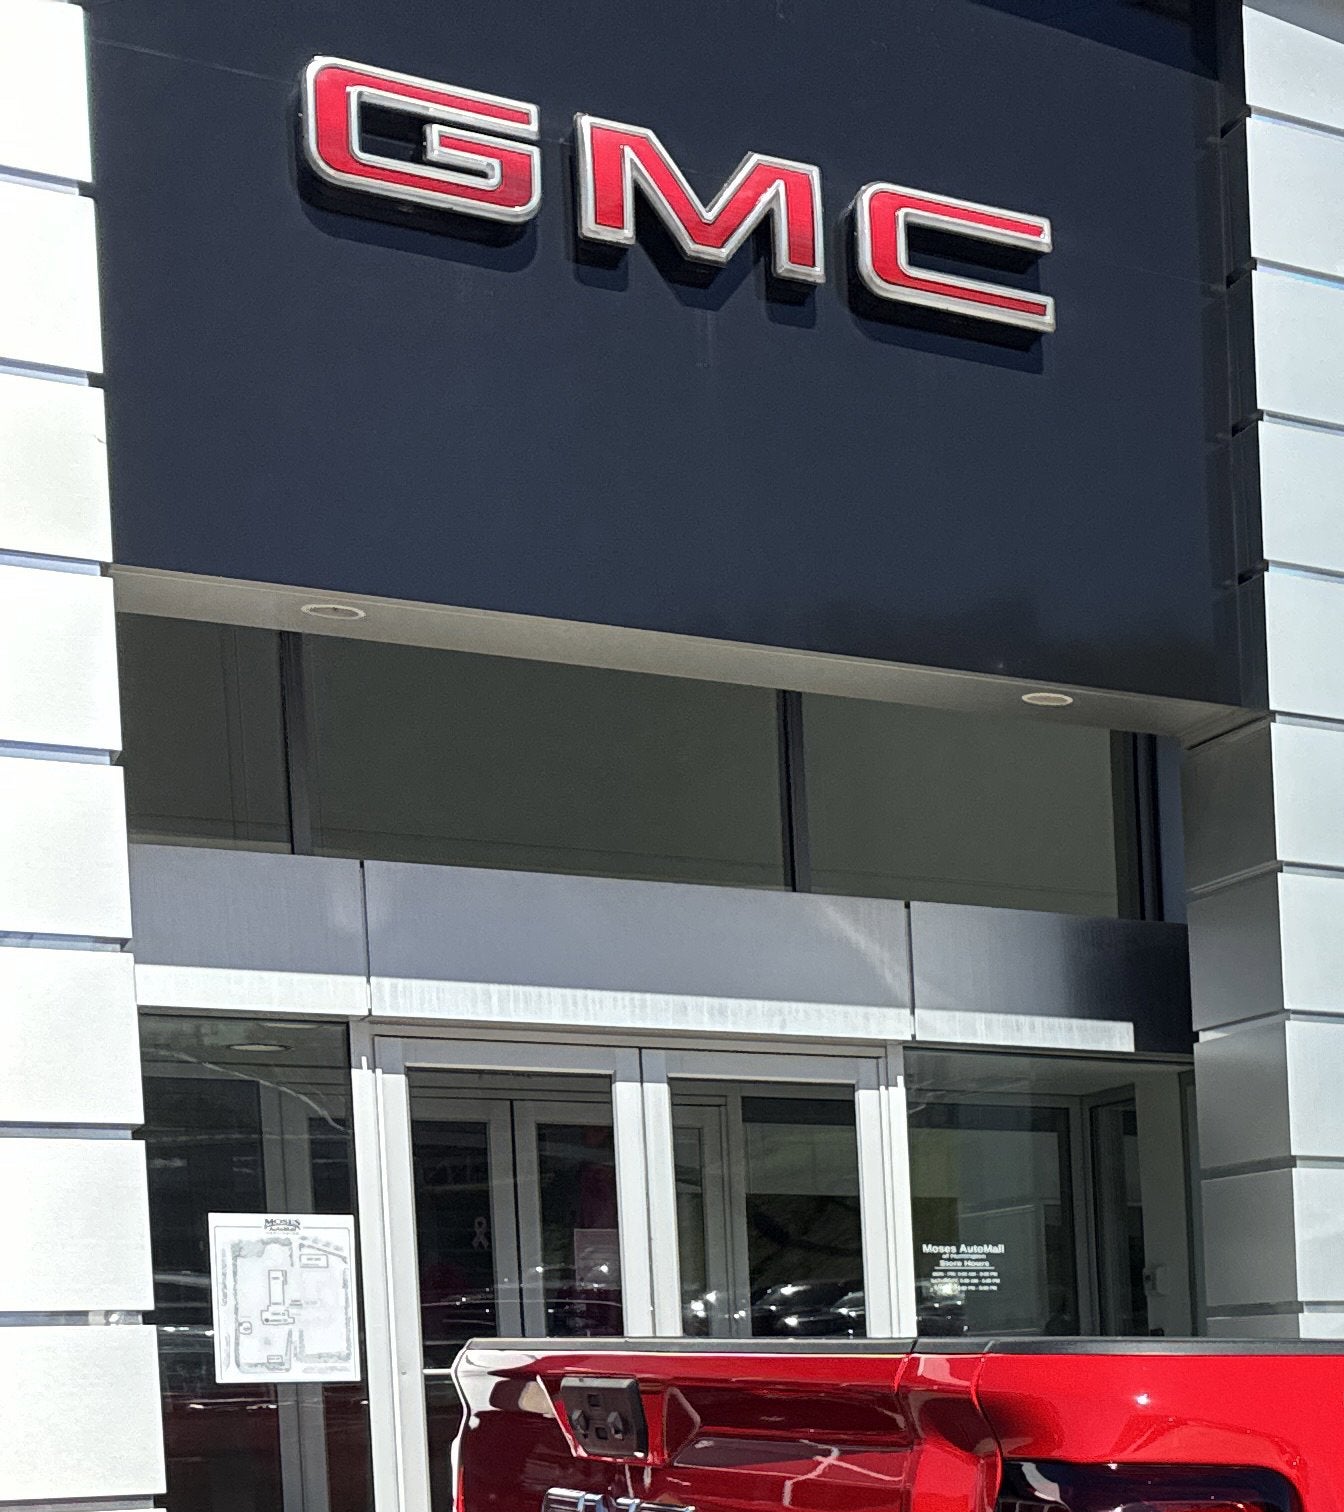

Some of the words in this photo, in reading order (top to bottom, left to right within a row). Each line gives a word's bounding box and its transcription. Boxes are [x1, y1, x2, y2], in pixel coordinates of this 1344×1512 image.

[302, 55, 1055, 332] GMC
[922, 1244, 957, 1253] Moses
[960, 1244, 1005, 1253] AutoMall
